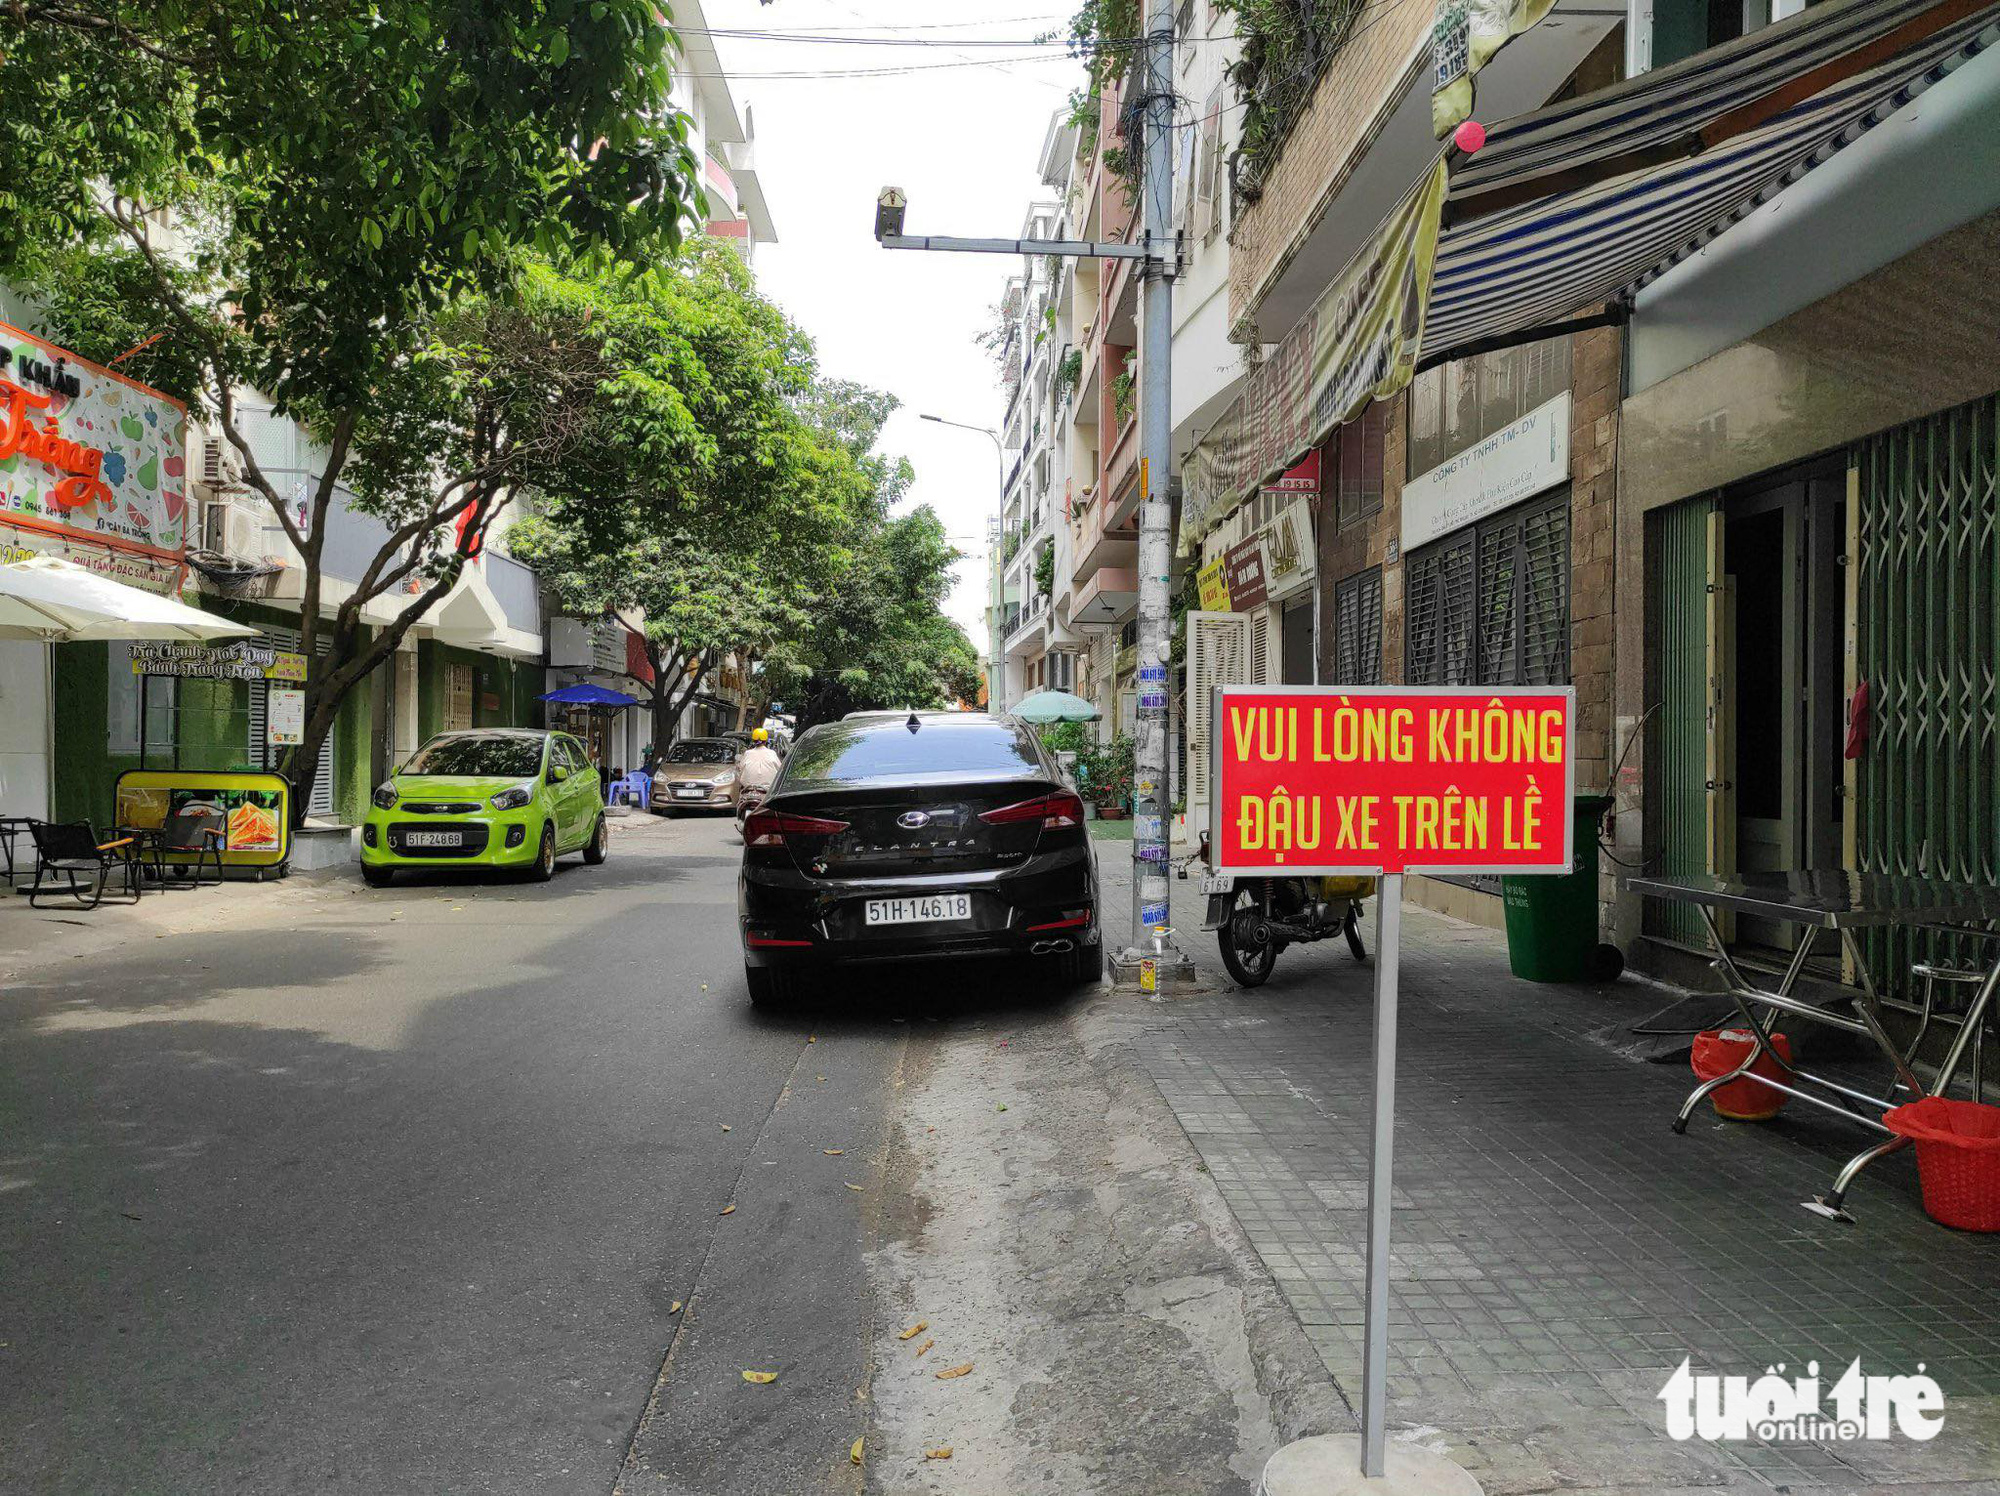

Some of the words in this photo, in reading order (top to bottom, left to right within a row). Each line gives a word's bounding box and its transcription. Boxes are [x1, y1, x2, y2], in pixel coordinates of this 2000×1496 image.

[1432, 462, 1457, 483] CÔNG
[1458, 454, 1471, 469] TY
[1473, 437, 1499, 462] TNHH
[1520, 415, 1537, 434] DV
[1230, 707, 1297, 763] VUI
[1313, 695, 1414, 763] LÒNG
[1428, 697, 1563, 764] KHÔNG
[1236, 784, 1321, 863] ĐẬU
[1335, 796, 1380, 850] XE
[1392, 784, 1488, 850] TRÊN
[1503, 774, 1543, 850] LỀ
[408, 834, 460, 845] 51F-248.68
[855, 839, 976, 852] ELANTRA
[1203, 879, 1229, 893] 6169
[869, 898, 967, 921] 51H-146.18
